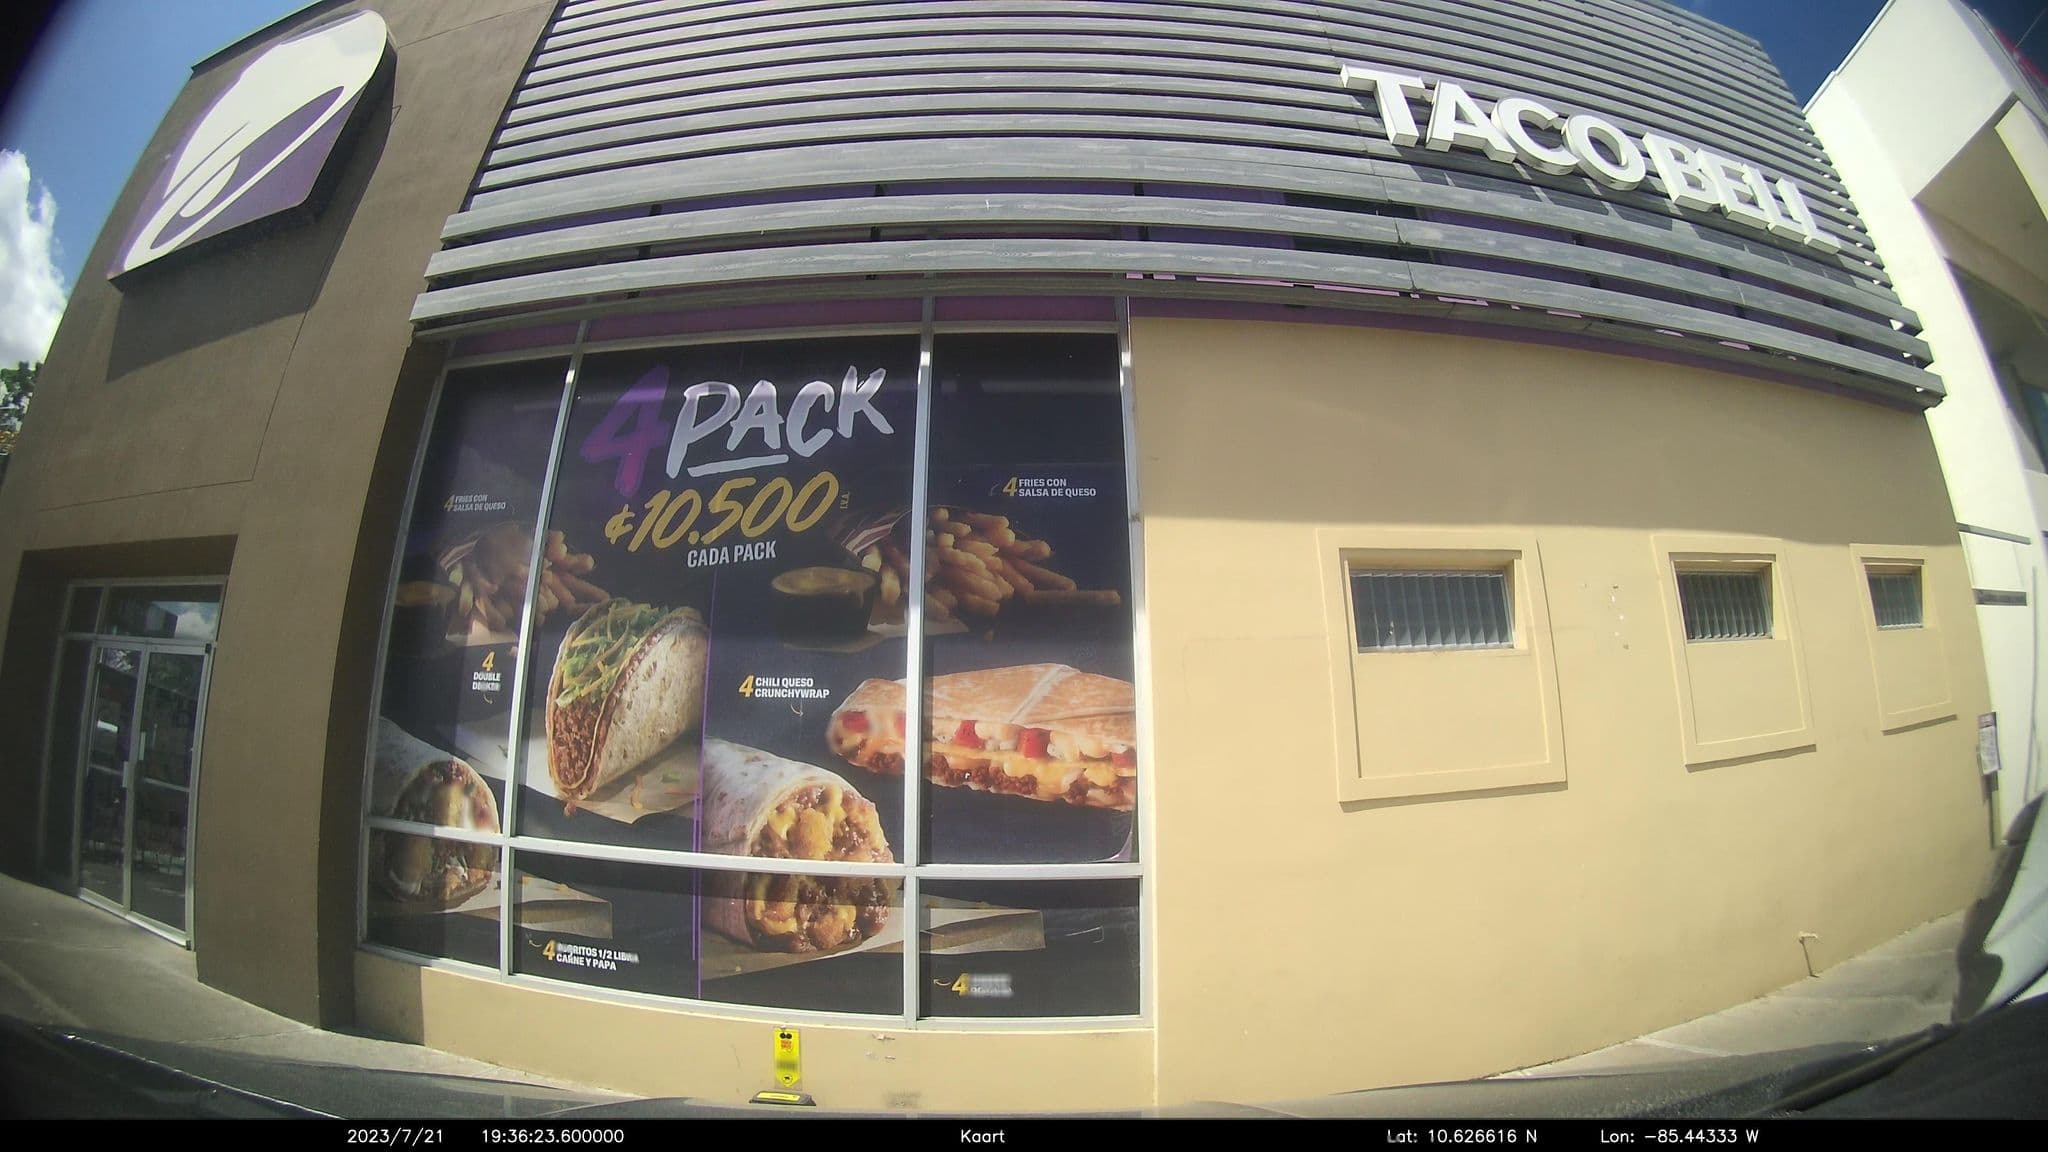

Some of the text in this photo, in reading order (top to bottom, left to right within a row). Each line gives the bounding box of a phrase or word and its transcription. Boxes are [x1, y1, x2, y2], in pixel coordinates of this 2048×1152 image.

[1339, 63, 1841, 255] TACO BELL
[580, 364, 895, 498] 4 PACK
[1002, 476, 1067, 497] 4 FRIES CON
[1018, 488, 1097, 498] SALSA DE QUESO
[443, 494, 456, 512] 4
[474, 494, 488, 502] CON
[475, 503, 483, 511] DE
[484, 502, 506, 511] QUESO
[687, 540, 776, 568] CADA PACK
[482, 651, 495, 671] 4
[738, 674, 814, 697] 4 CHILI QUESO
[754, 688, 830, 698] CRUNCHYWRAP
[542, 939, 557, 961] 4
[598, 949, 613, 960] 1/2
[556, 953, 618, 971] CARNE Y PAPA
[951, 972, 970, 997] 4
